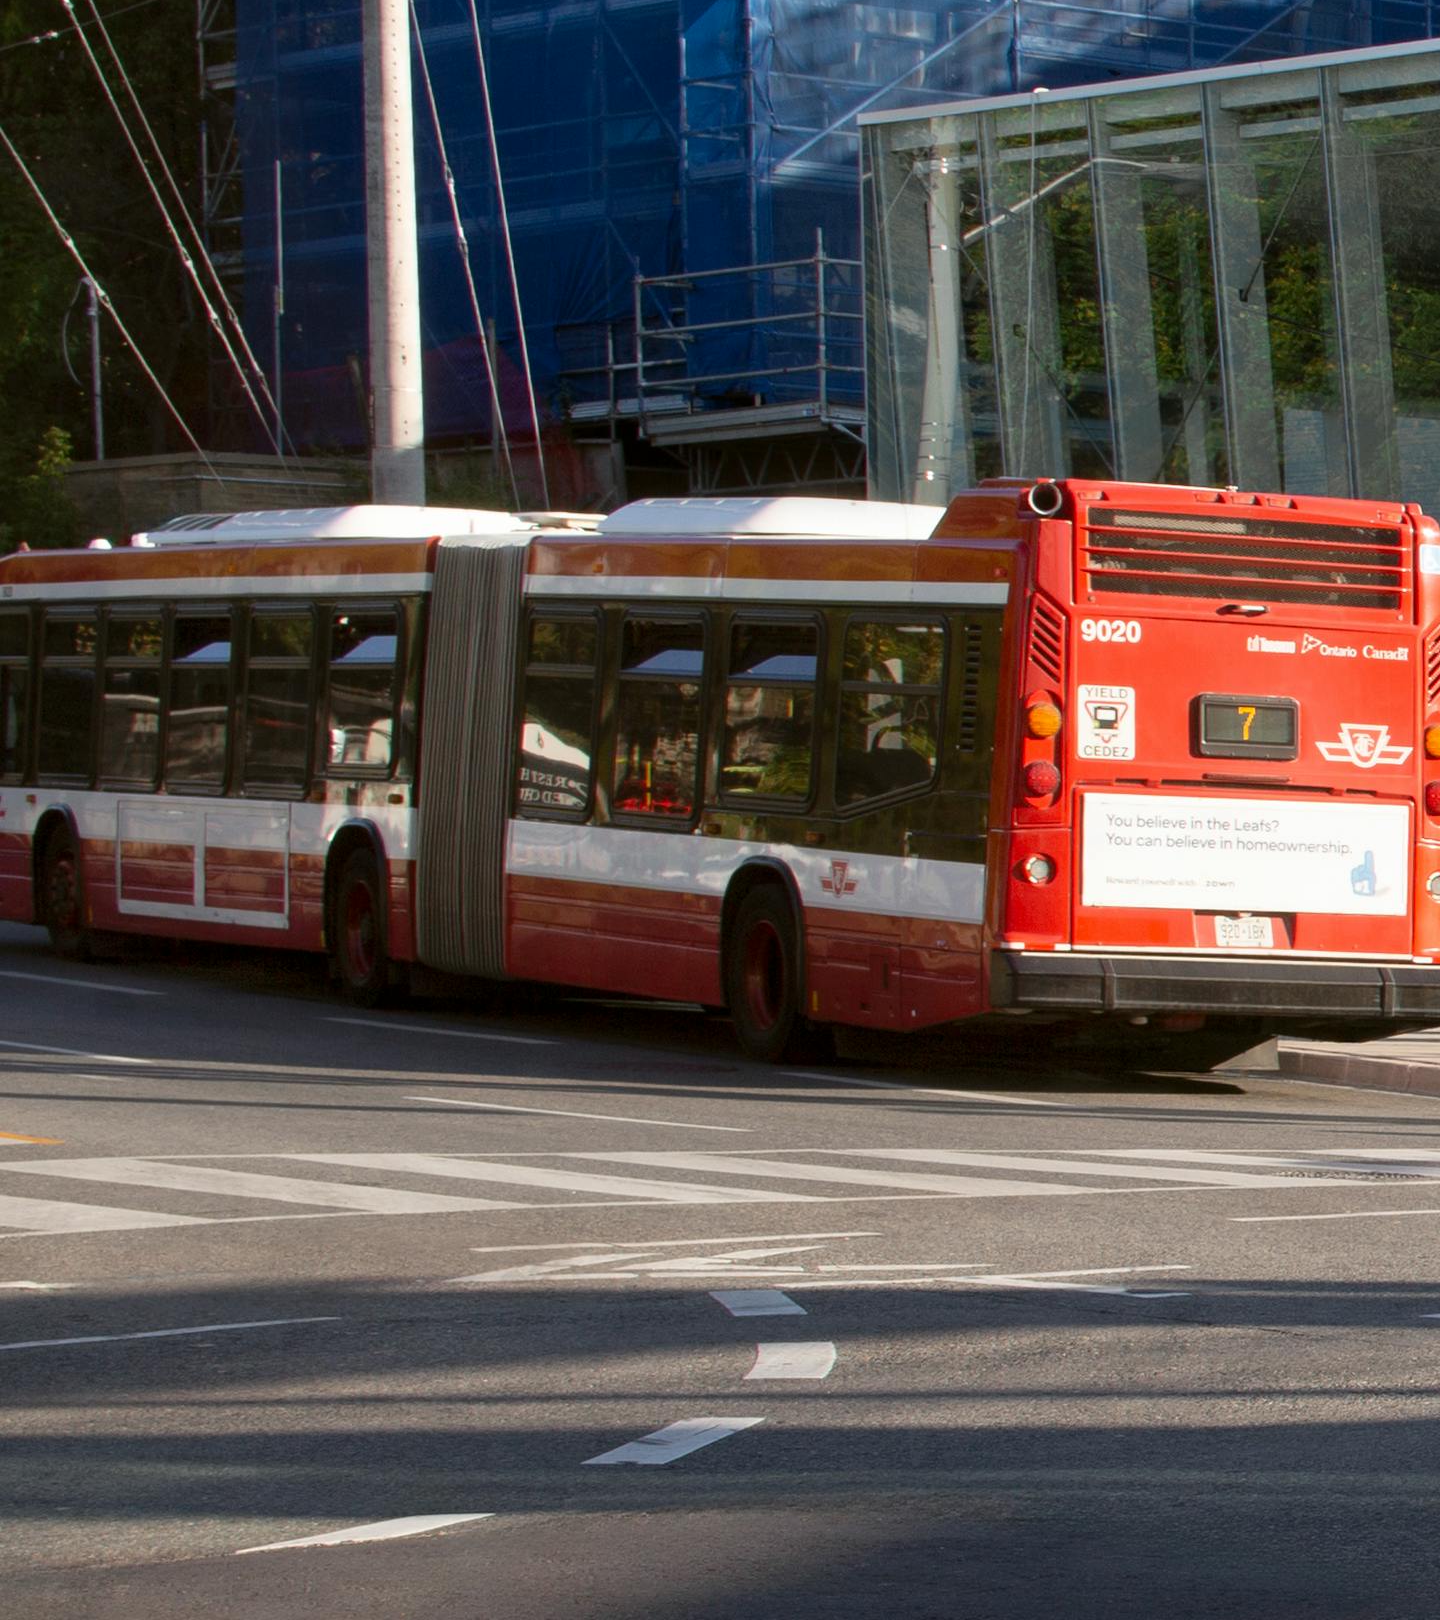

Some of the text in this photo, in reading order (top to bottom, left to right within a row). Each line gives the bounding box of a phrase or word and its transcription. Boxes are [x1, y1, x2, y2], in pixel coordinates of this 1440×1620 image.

[1081, 619, 1142, 643] 9020
[1319, 644, 1357, 658] Ontario
[1362, 645, 1409, 661] Canada
[1084, 686, 1129, 699] YIELD
[1238, 706, 1256, 740] 7
[1106, 813, 1280, 832] You believe in the Leafs?
[1106, 832, 1353, 857] You can believe in homeownership.
